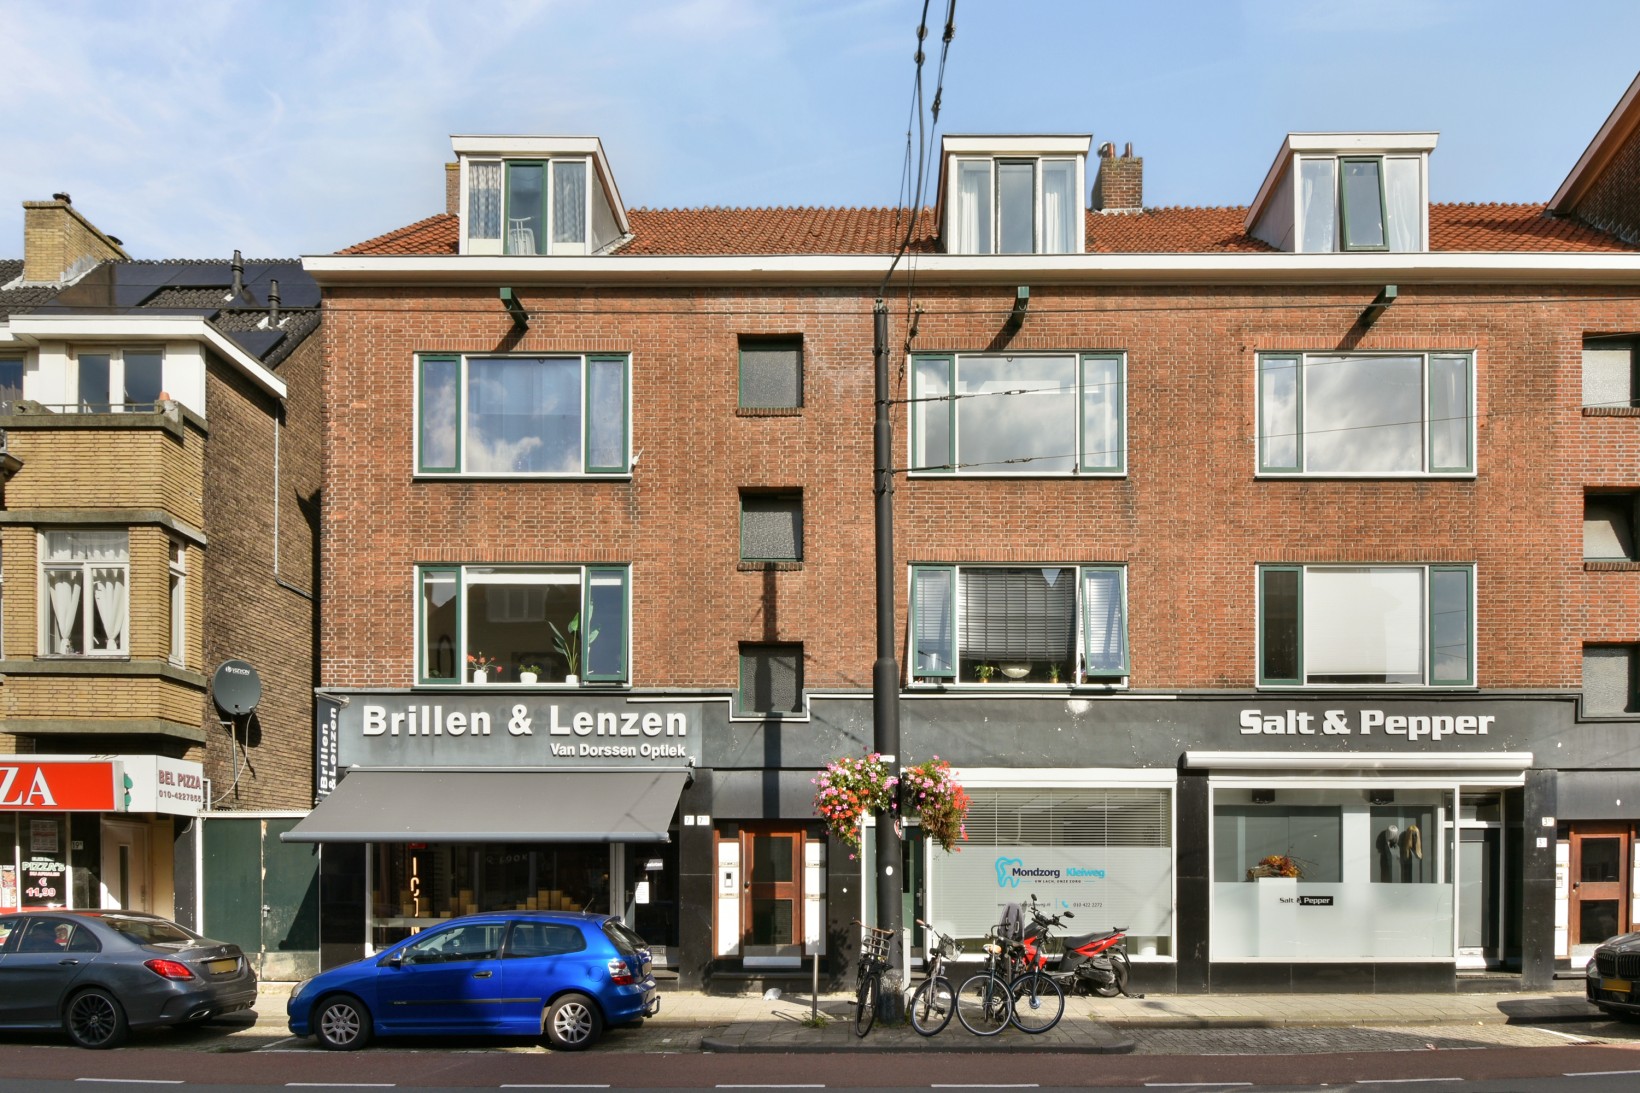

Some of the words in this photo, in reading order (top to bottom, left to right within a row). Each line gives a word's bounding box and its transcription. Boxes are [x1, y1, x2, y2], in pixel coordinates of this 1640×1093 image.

[363, 705, 491, 736] Brillen
[507, 704, 533, 736] &
[550, 705, 687, 736] Lenzen
[1240, 709, 1315, 735] Salt
[1322, 709, 1351, 735] &
[1359, 709, 1496, 741] Pepper
[320, 723, 329, 789] Brillen
[550, 743, 575, 757] Van
[579, 743, 636, 757] Dorssen
[640, 743, 686, 760] Optiek
[158, 769, 176, 786] BEL
[177, 772, 201, 790] PIZZA
[22, 861, 66, 872] PIZZA'S
[1012, 868, 1060, 878] Mondzorg
[1066, 868, 1105, 878] Kleiweg
[1303, 897, 1331, 905] Pepper
